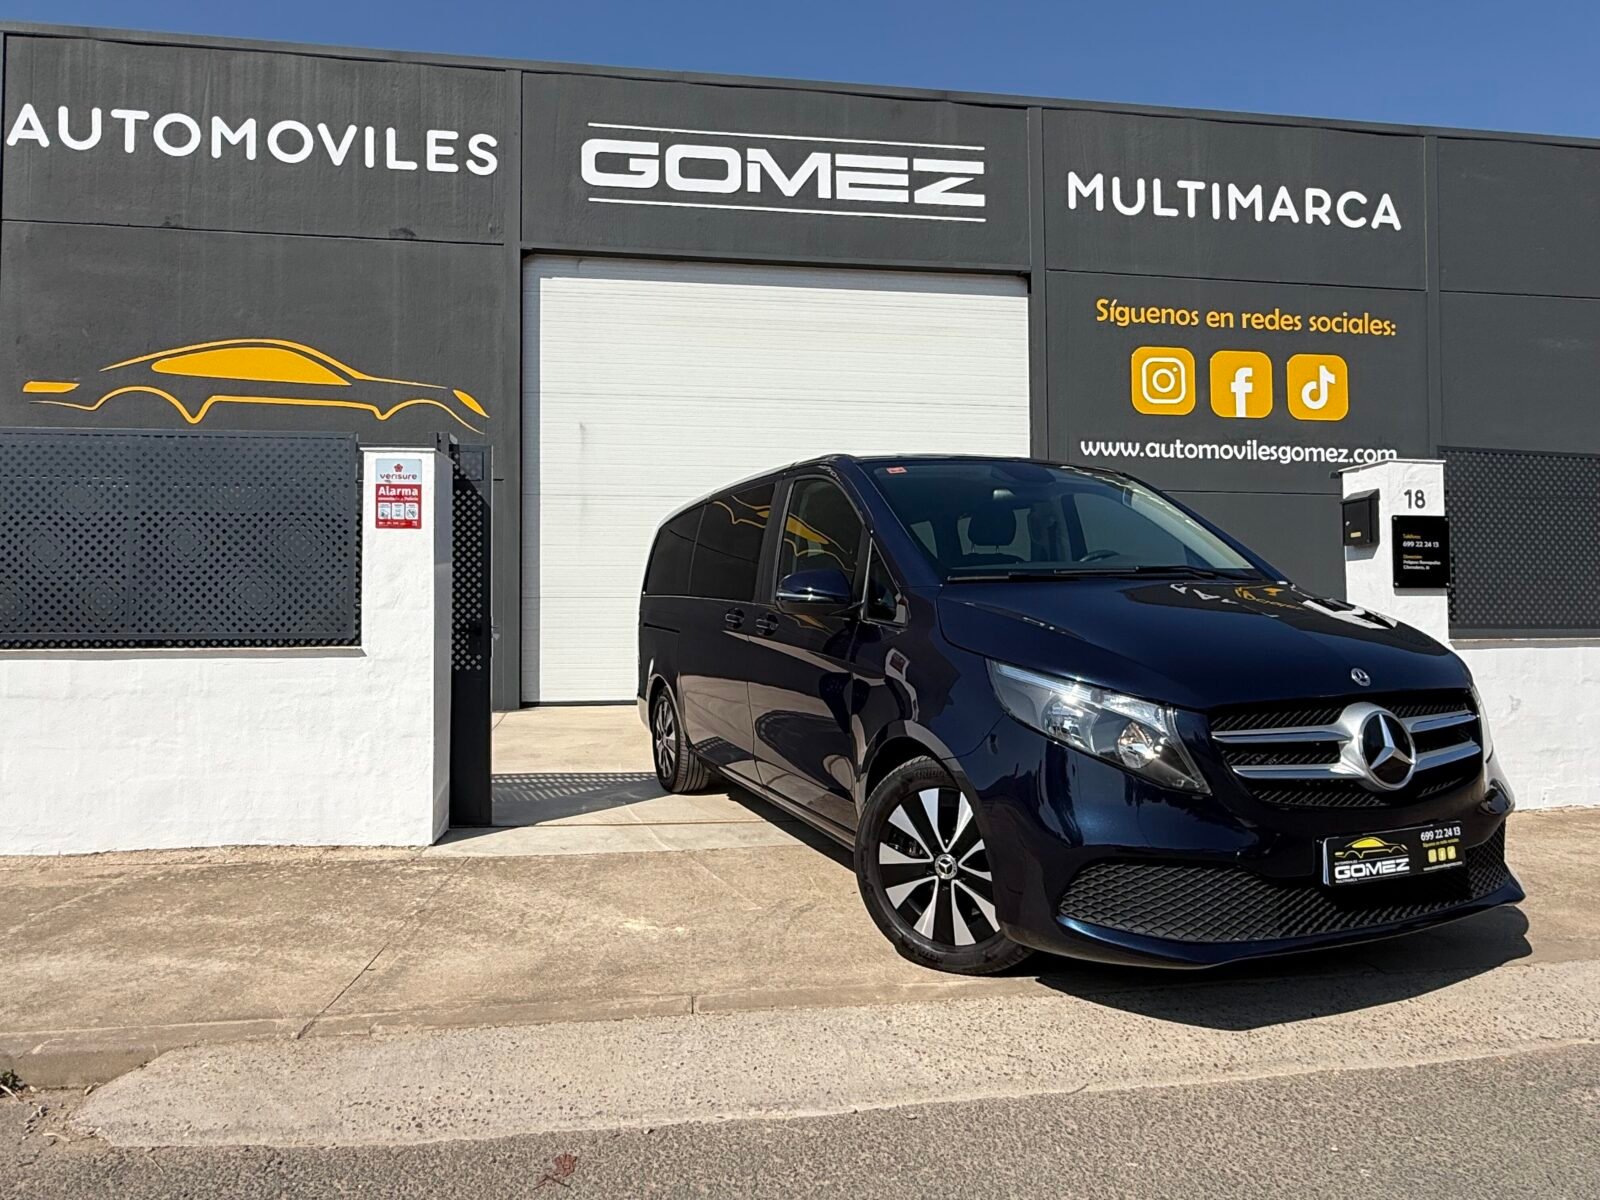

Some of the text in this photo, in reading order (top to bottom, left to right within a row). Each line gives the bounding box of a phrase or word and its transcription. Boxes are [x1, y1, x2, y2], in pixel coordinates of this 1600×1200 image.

[6, 103, 499, 176] AUTOMOVILES
[580, 138, 986, 207] GOMEZ
[1067, 171, 1402, 231] MULTIMARCA
[1096, 298, 1397, 337] Síguenos en redes sociales:
[1080, 439, 1398, 464] www.automovilesgomez.com
[379, 486, 418, 496] Alarma
[1403, 489, 1426, 509] 18
[1421, 826, 1461, 841] 699 22 24 13
[1335, 858, 1410, 879] GOMEZ
